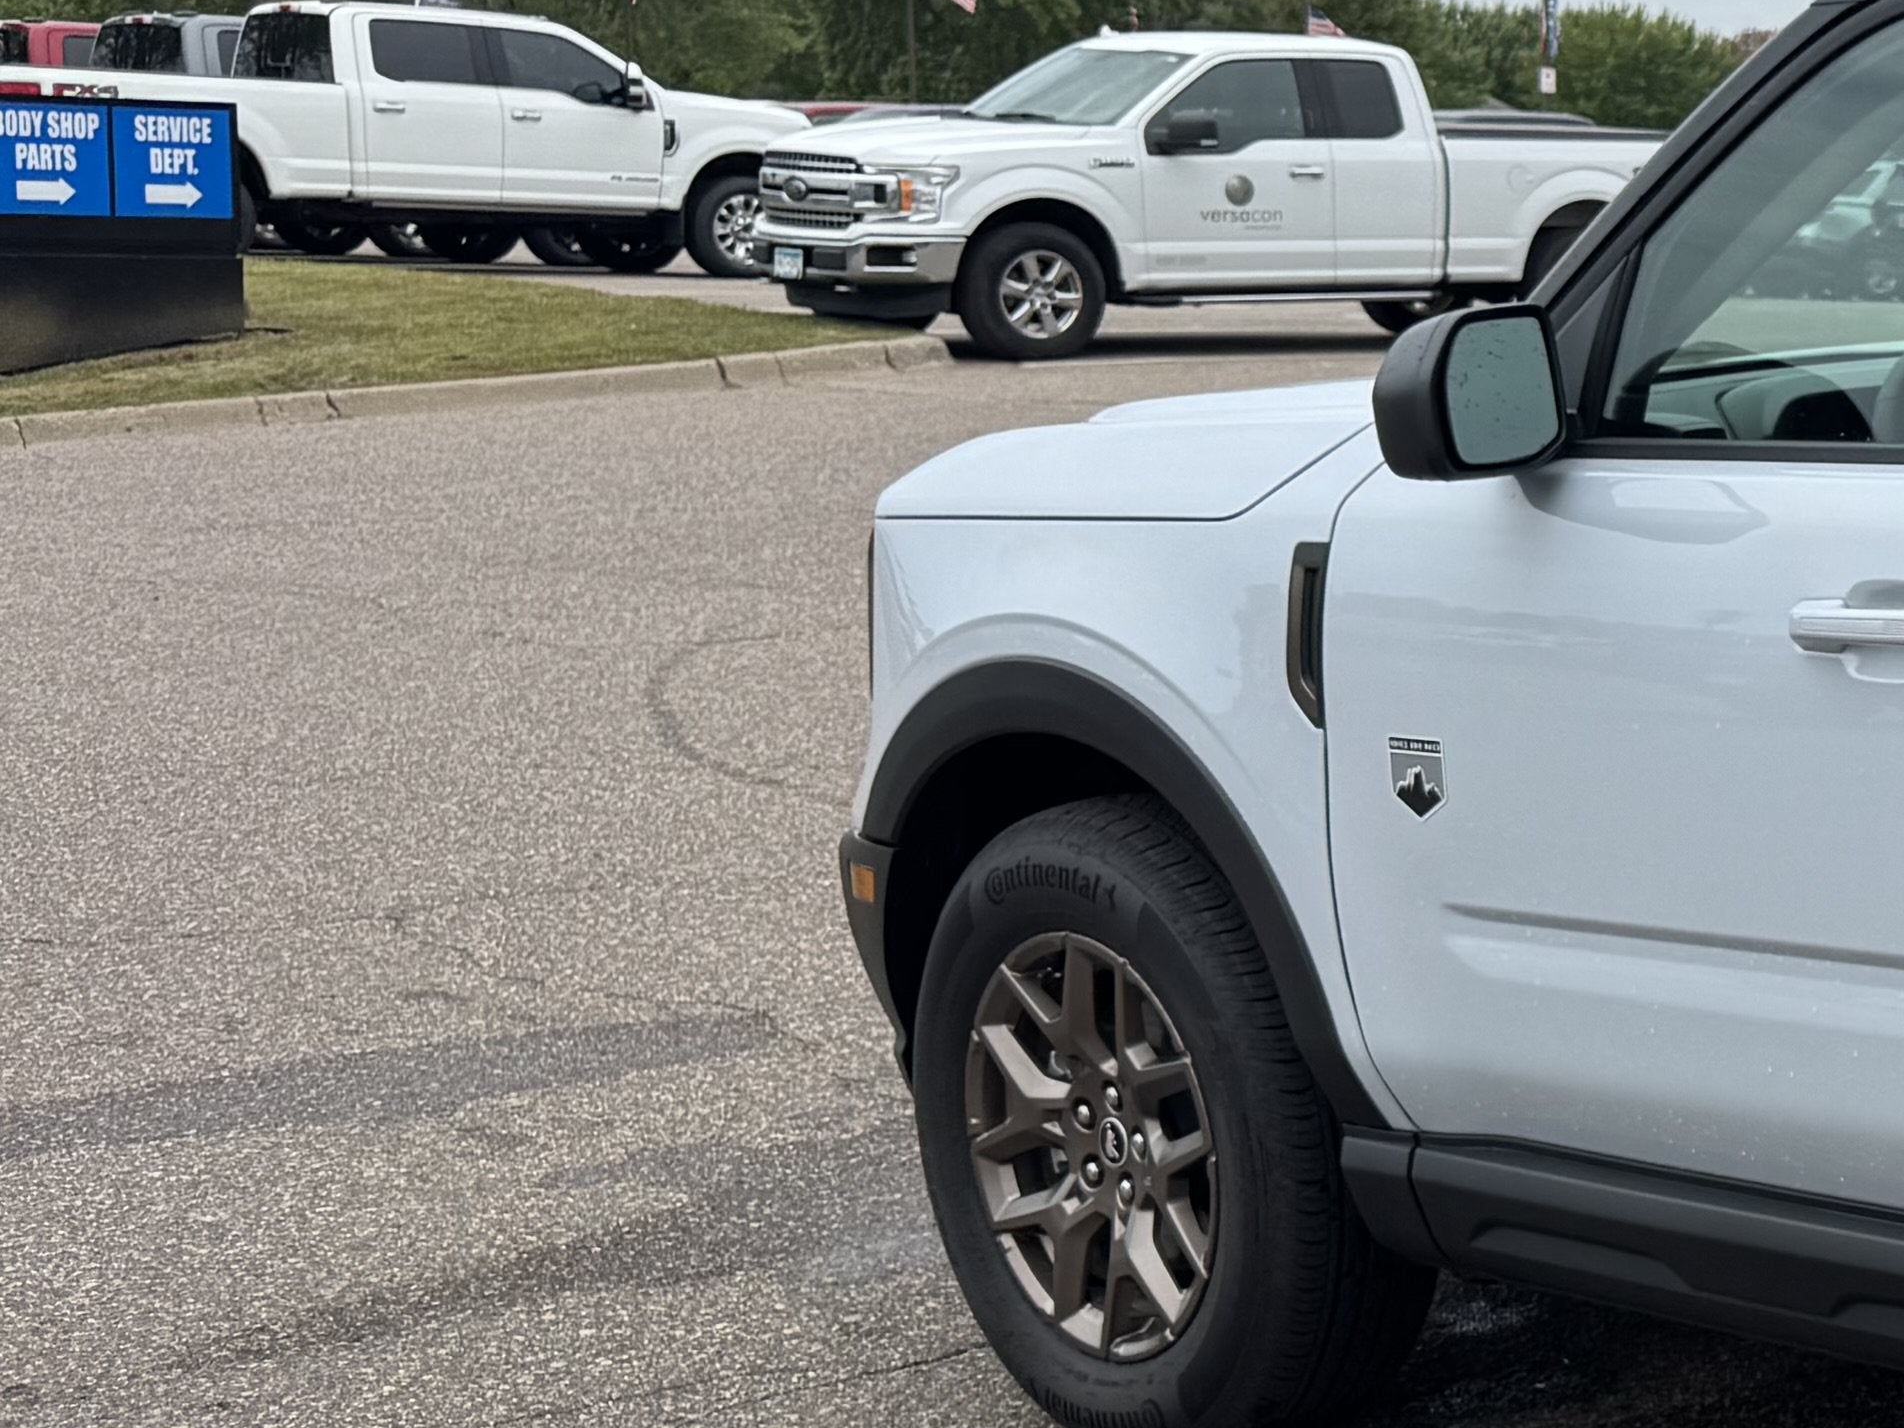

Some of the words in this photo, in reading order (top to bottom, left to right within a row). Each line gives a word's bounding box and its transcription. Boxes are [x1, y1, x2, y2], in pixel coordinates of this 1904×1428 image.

[47, 111, 100, 140] SHOP
[134, 114, 212, 144] SERVICE
[15, 142, 77, 172] PARTS
[150, 148, 200, 176] DEPT.
[984, 855, 1101, 905] Continental
